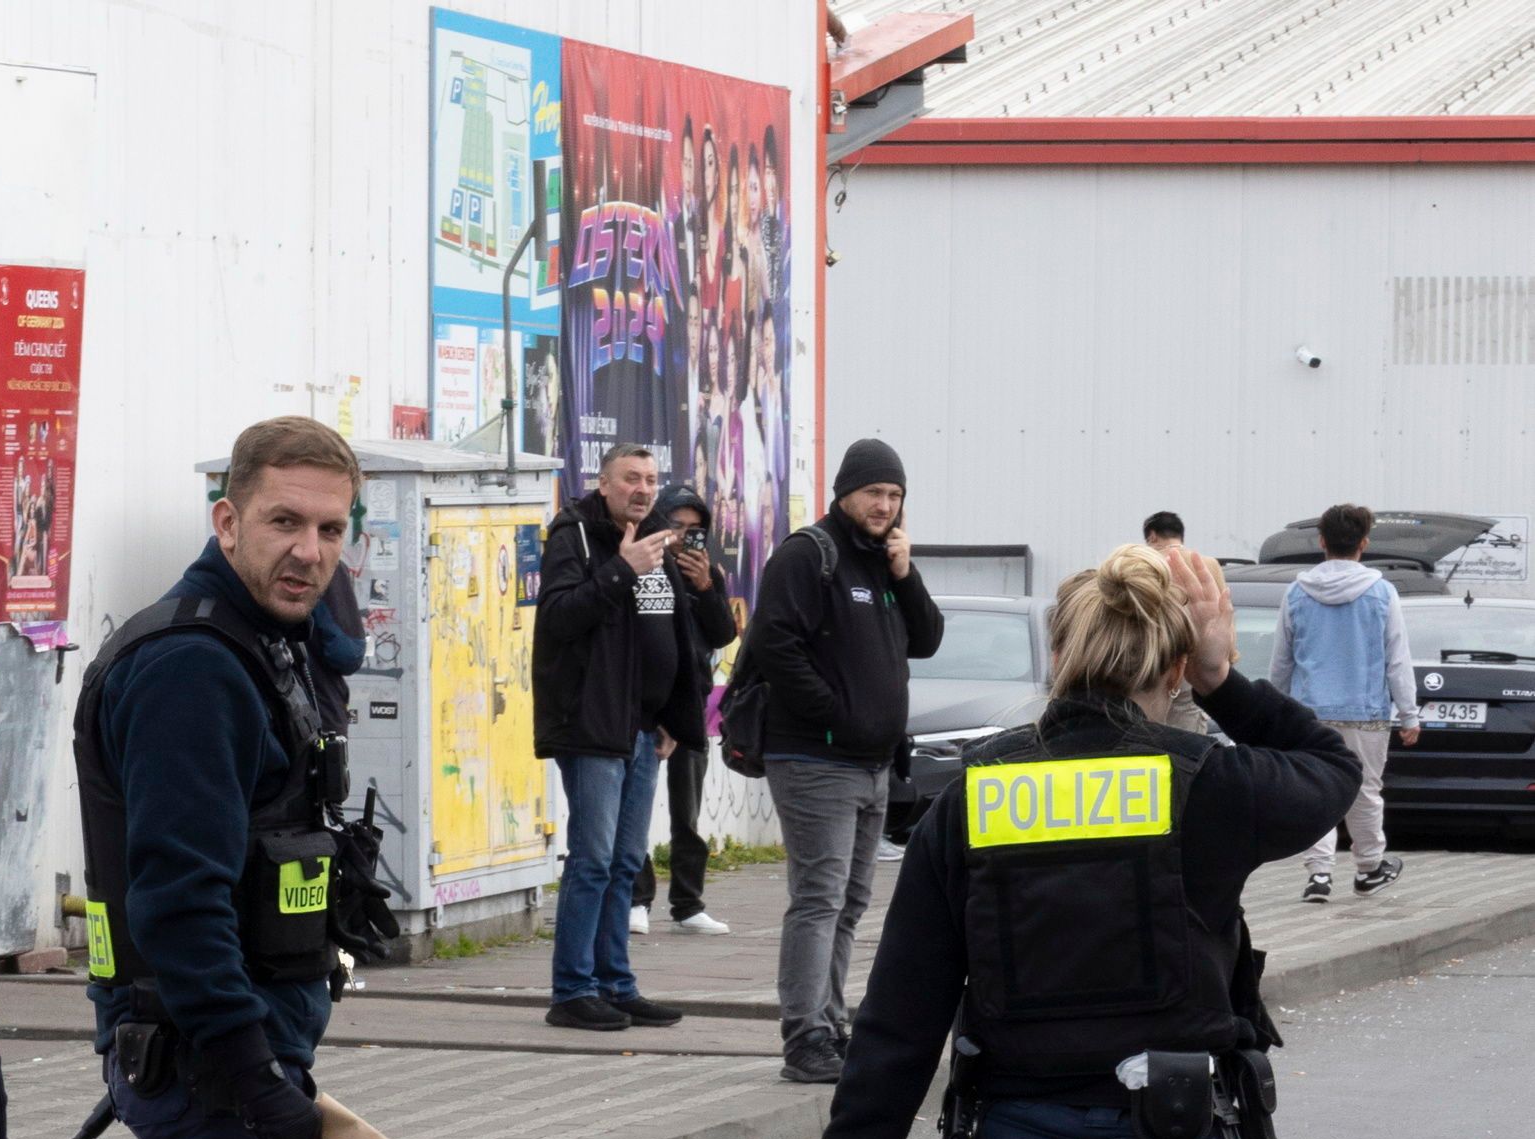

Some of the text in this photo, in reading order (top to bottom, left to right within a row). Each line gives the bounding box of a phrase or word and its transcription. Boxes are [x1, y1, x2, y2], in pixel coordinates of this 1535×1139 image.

[568, 201, 684, 312] OSTERN
[26, 289, 59, 309] QUEENS
[592, 287, 668, 377] 2024
[1438, 704, 1478, 720] 9435
[977, 768, 1159, 834] POLIZEI
[284, 885, 324, 909] VIDEO
